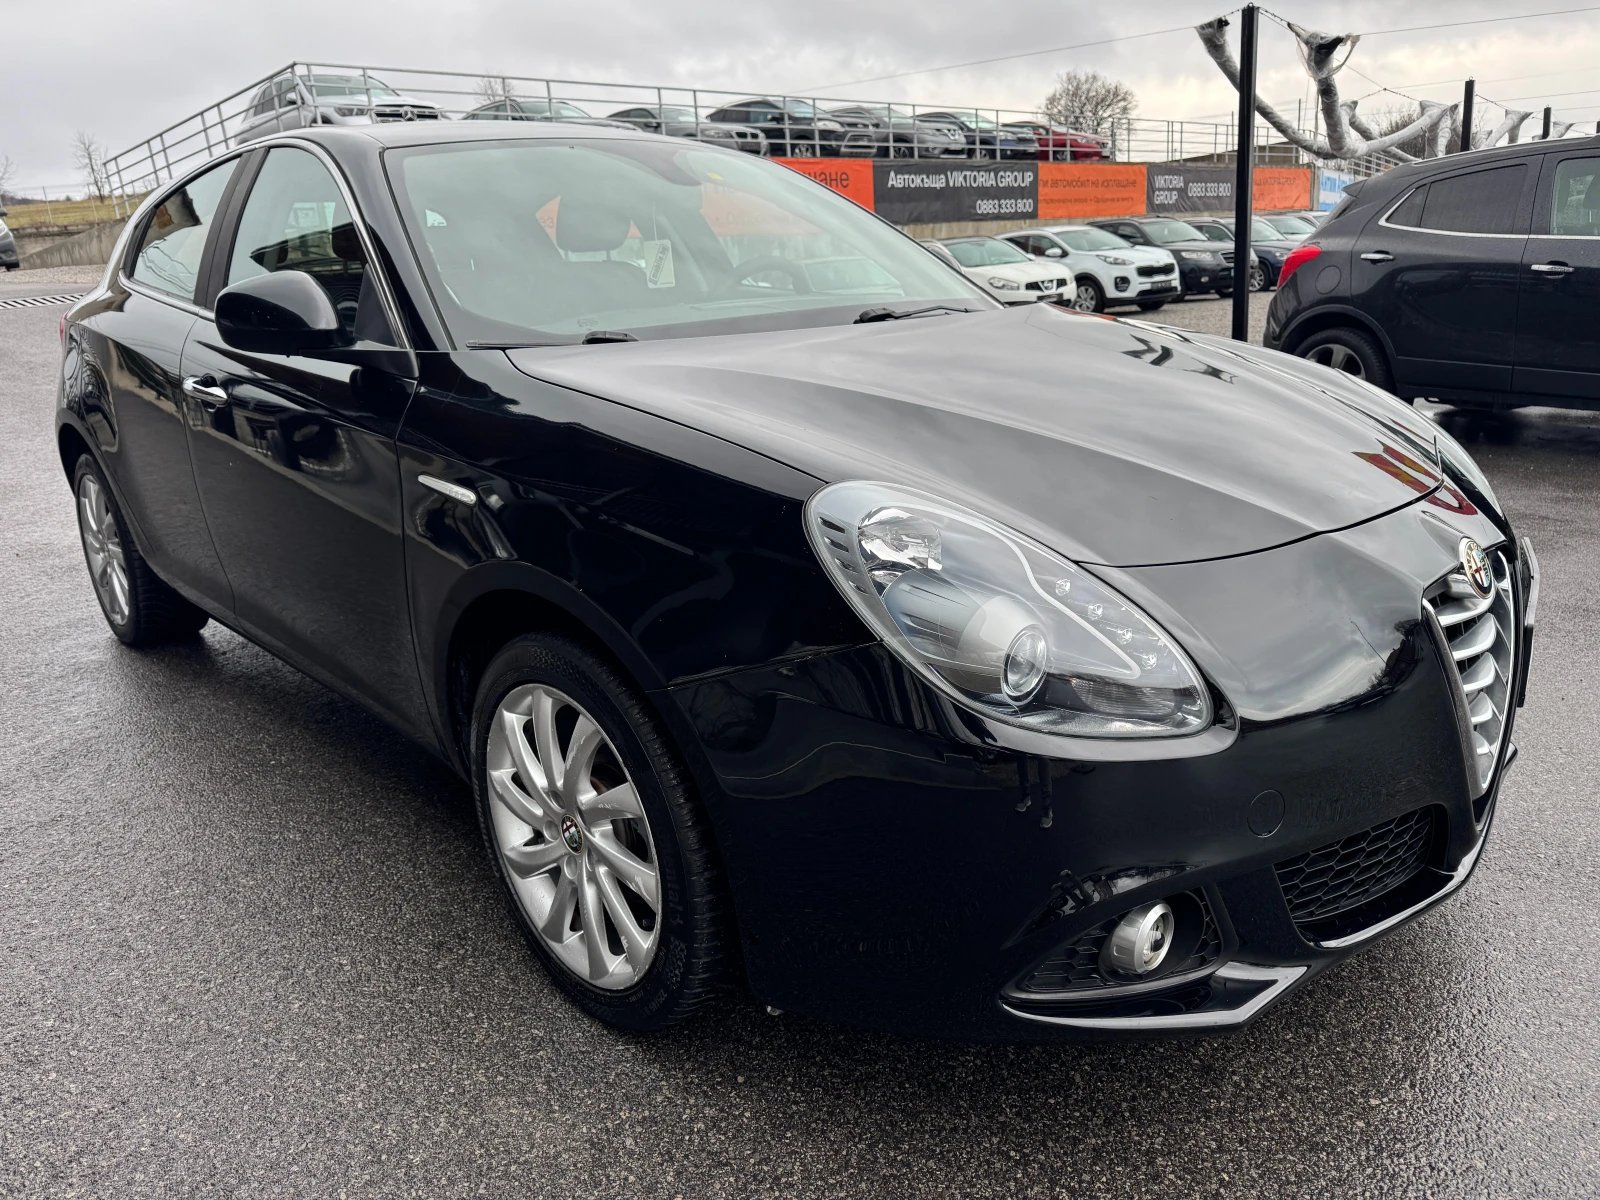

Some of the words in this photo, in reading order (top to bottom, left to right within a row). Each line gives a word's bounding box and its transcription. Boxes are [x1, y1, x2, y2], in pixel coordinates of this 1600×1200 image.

[887, 170, 946, 189] Автокъща
[947, 170, 997, 188] VIKTORIA
[997, 171, 1034, 188] GROUP
[1091, 179, 1099, 188] на
[1154, 175, 1184, 189] VIKTORIA
[1154, 190, 1178, 204] GROUP
[1188, 182, 1205, 197] 0883
[1206, 182, 1218, 197] 333
[1218, 182, 1232, 197] 800
[976, 199, 999, 214] 0883
[1000, 199, 1016, 213] 333
[1016, 198, 1034, 212] 800
[652, 246, 667, 279] mobile.bg
